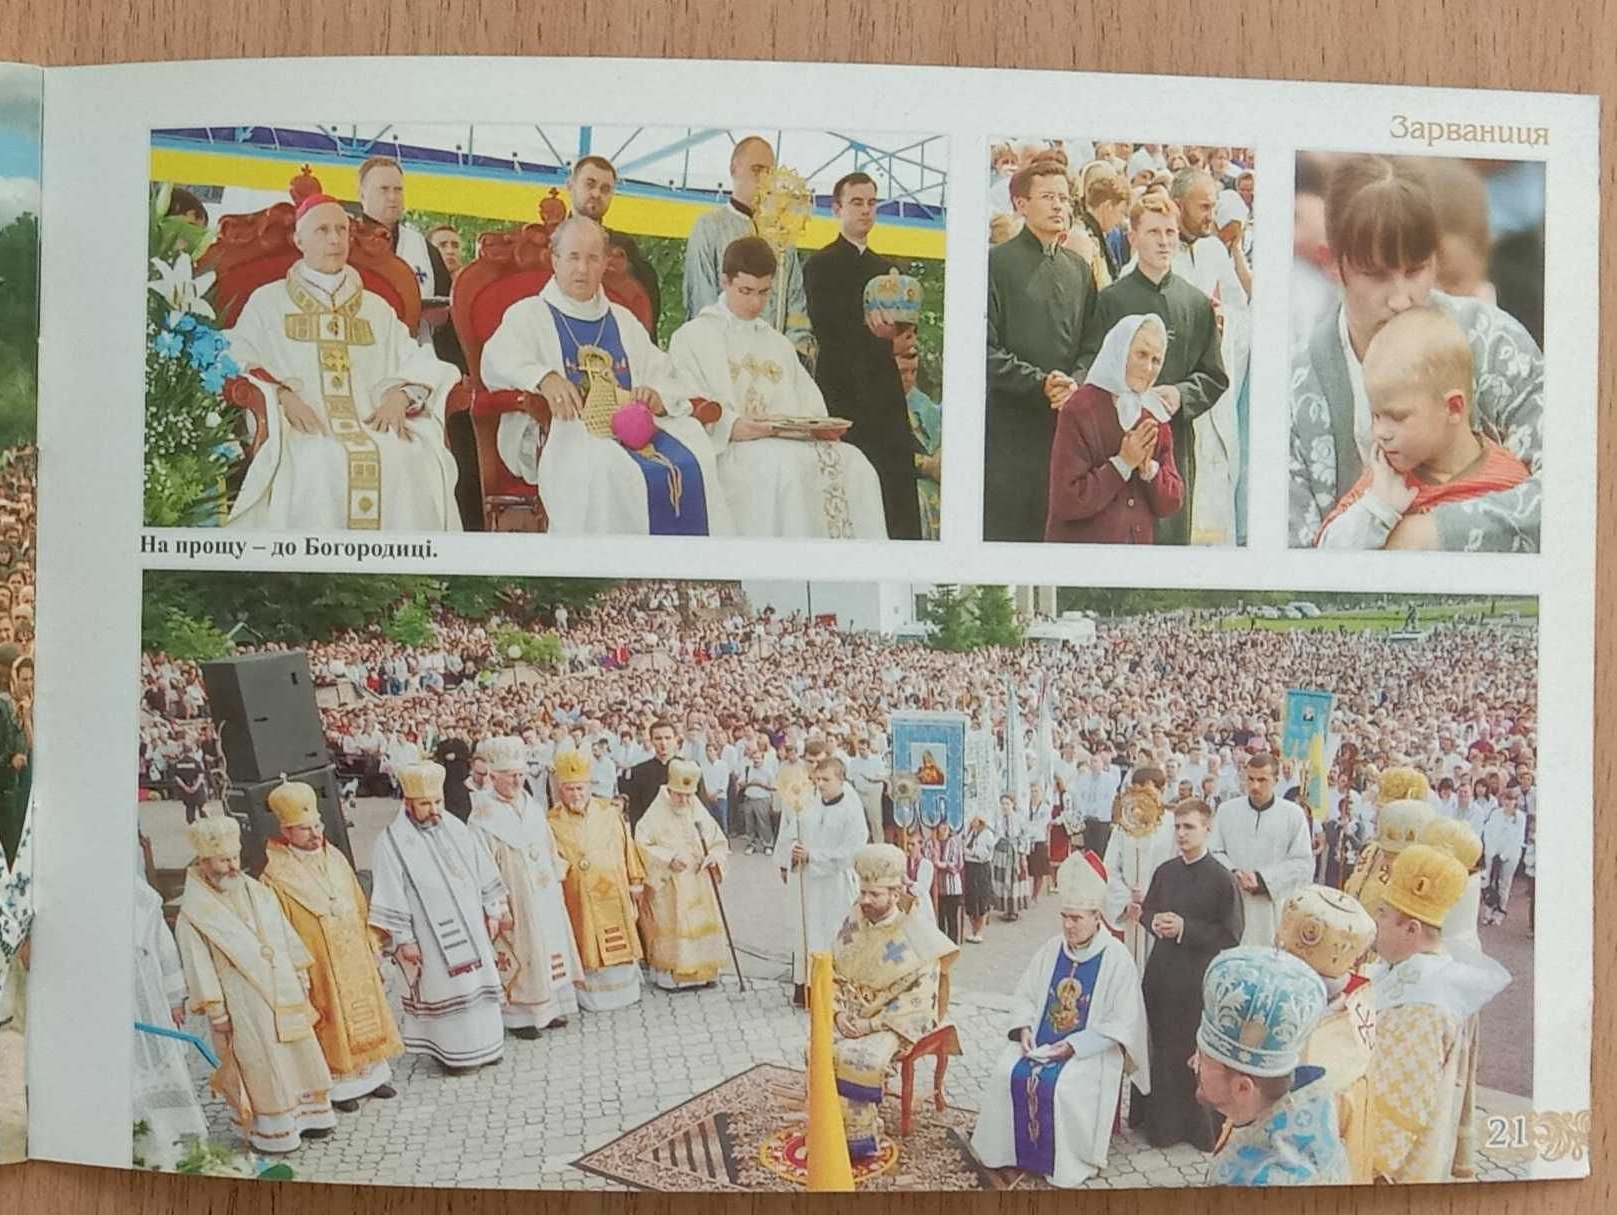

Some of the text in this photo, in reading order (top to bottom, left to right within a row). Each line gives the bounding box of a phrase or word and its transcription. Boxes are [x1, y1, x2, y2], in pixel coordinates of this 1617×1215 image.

[1390, 115, 1550, 146] Зарваниця
[140, 535, 168, 553] На
[175, 539, 246, 558] прощу
[271, 541, 297, 557] до
[305, 537, 438, 561] Богородиці.
[1485, 1115, 1529, 1147] 21
